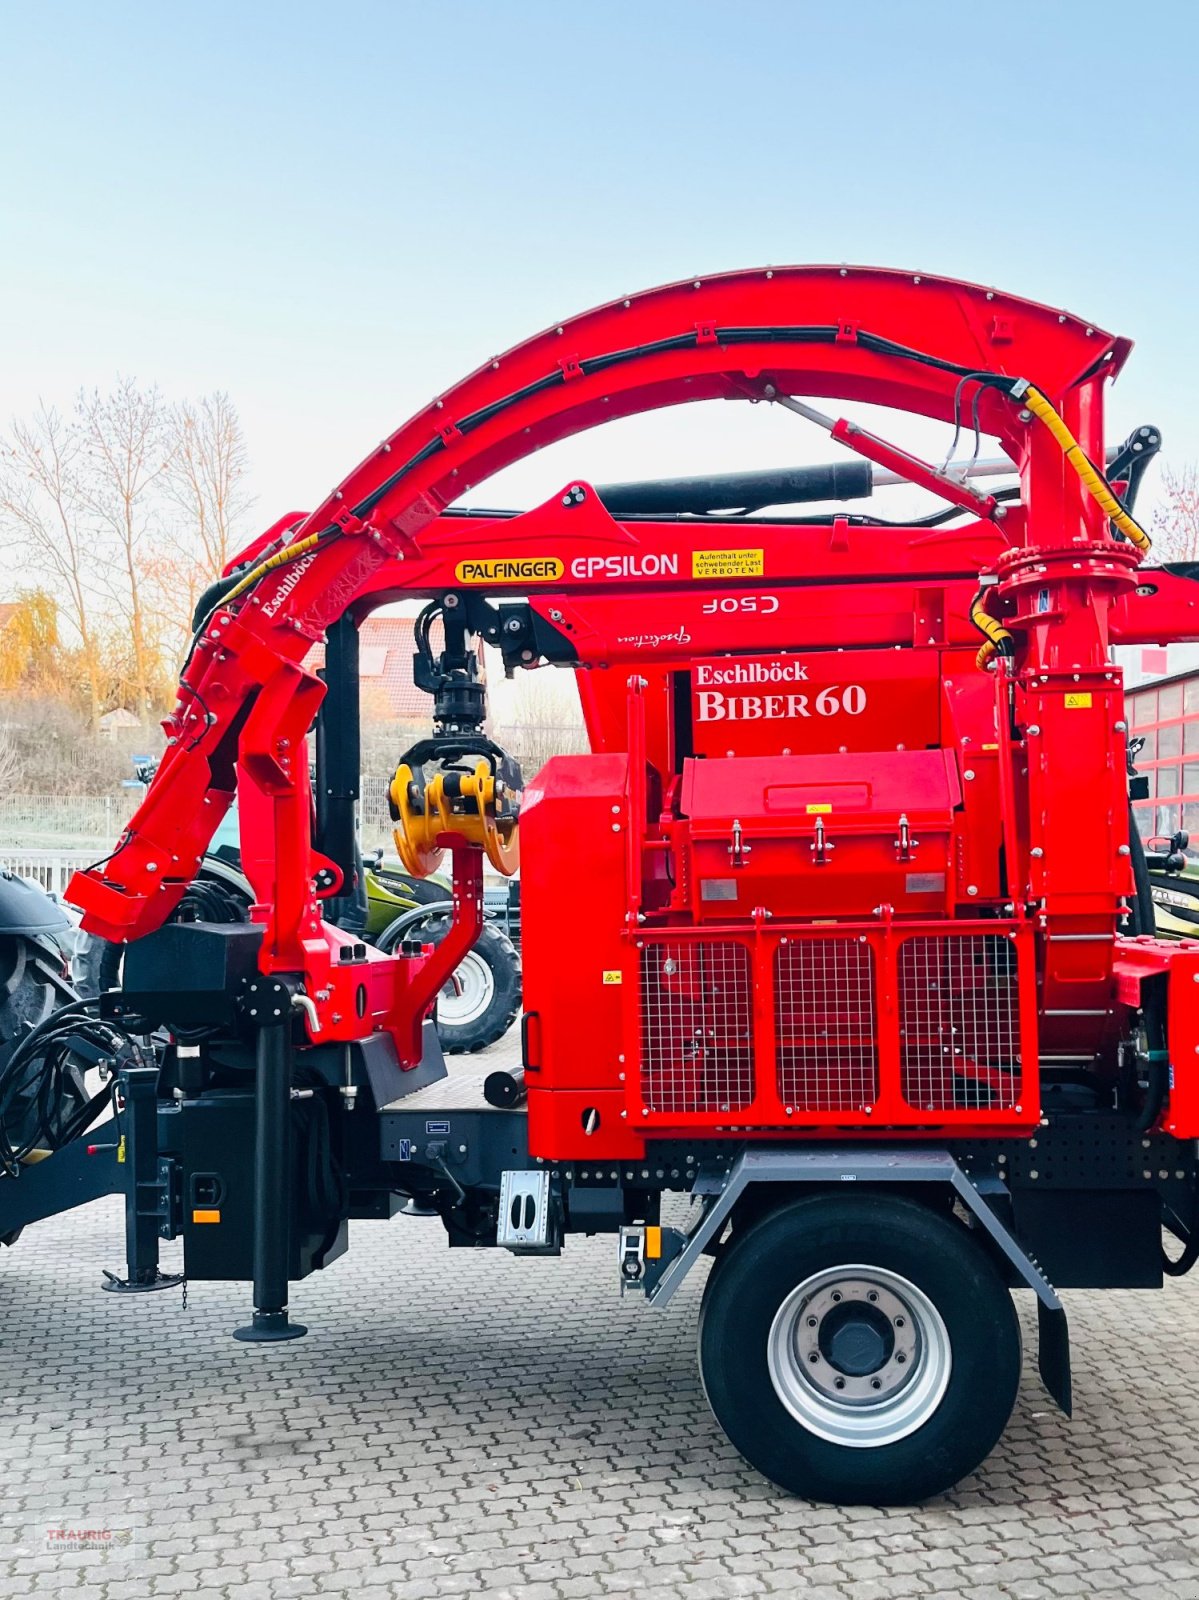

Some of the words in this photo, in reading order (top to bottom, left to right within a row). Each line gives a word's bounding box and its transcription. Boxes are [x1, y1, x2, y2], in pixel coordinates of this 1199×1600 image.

[462, 561, 557, 579] PALFINGER
[571, 553, 678, 578] EPSILON
[703, 596, 779, 614] C50F
[696, 661, 809, 686] Eschlböck
[815, 685, 867, 716] 60
